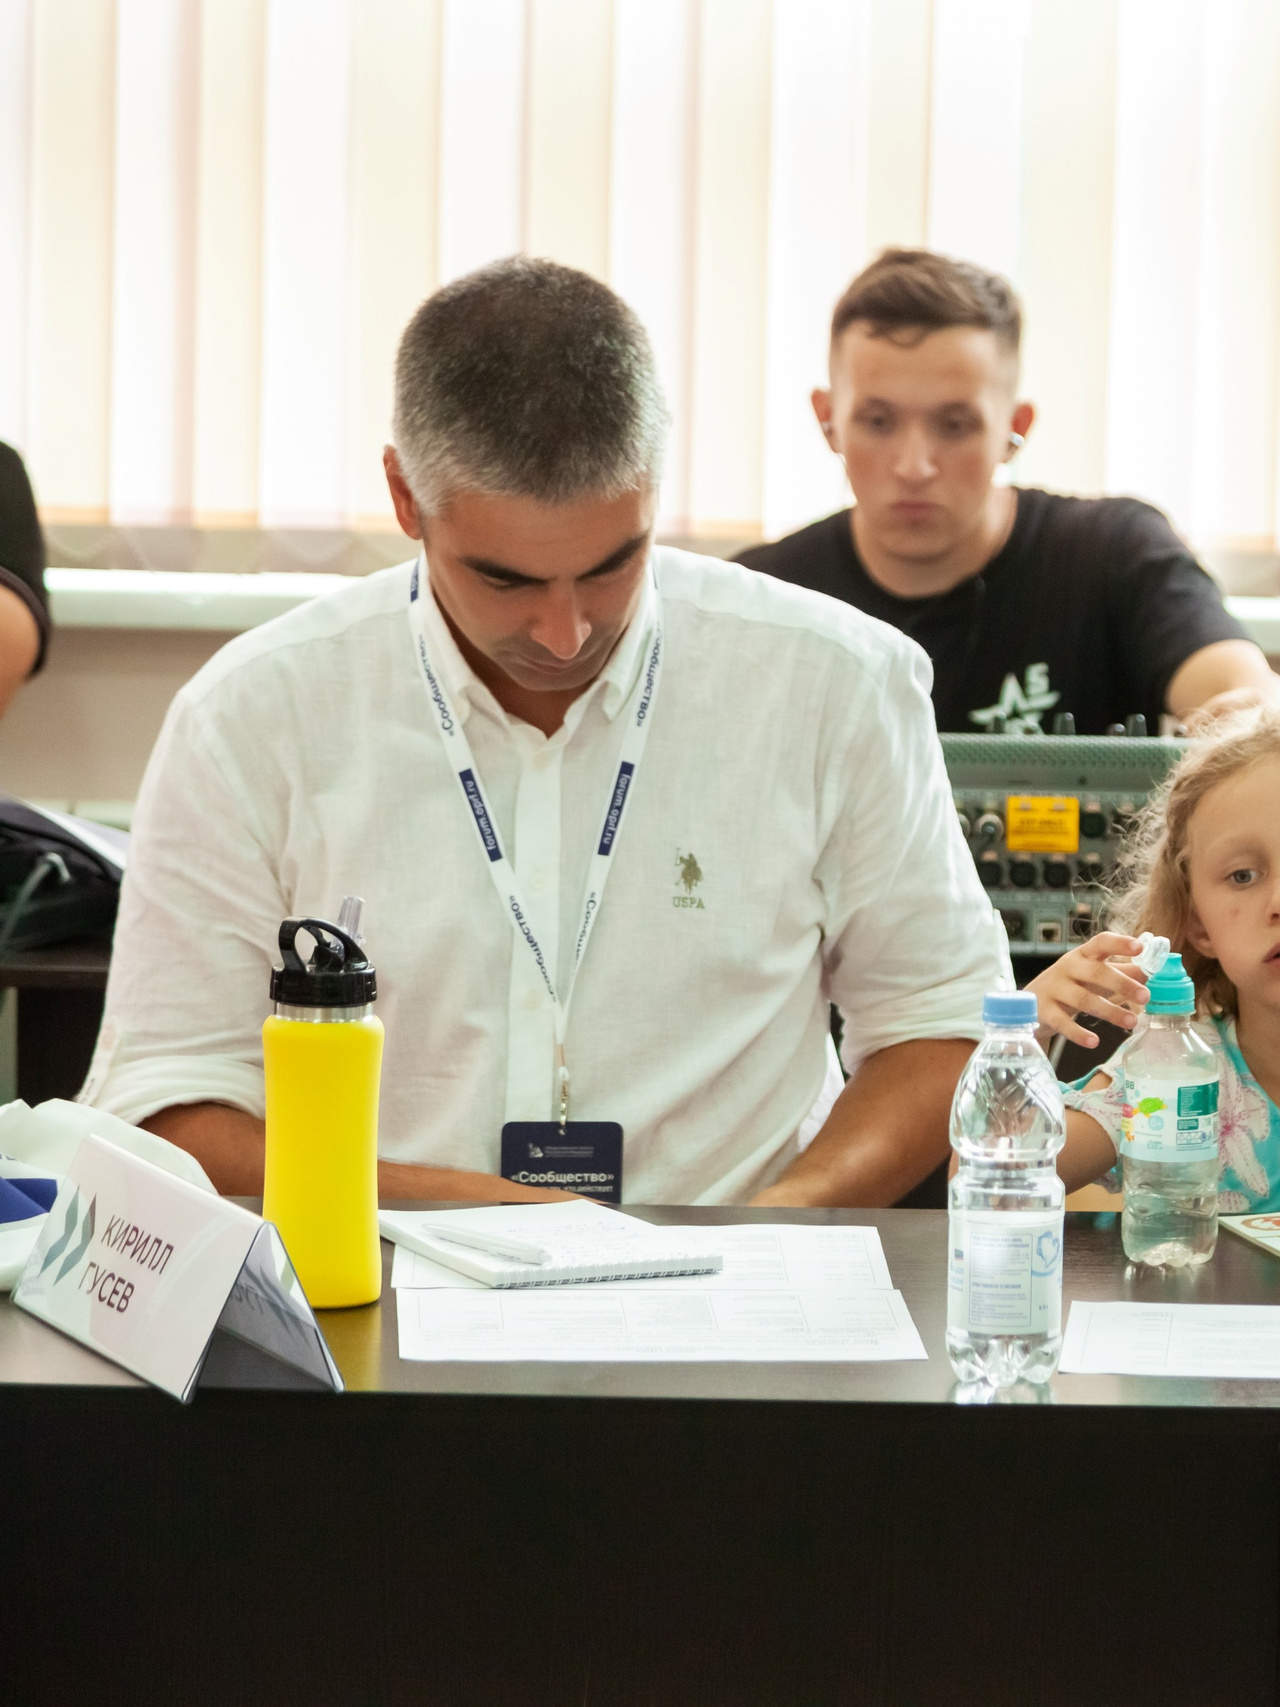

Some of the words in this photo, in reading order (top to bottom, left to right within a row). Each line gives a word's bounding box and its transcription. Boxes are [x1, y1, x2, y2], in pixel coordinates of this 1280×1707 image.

[465, 780, 497, 851] forum.oprf.ru
[602, 773, 631, 845] forum.oprf.ru
[673, 896, 705, 909] USPA
[510, 1171, 614, 1183] «Сообщество»
[101, 1214, 174, 1275] КИРИЛЛ
[78, 1261, 135, 1313] ГУСЕВ
